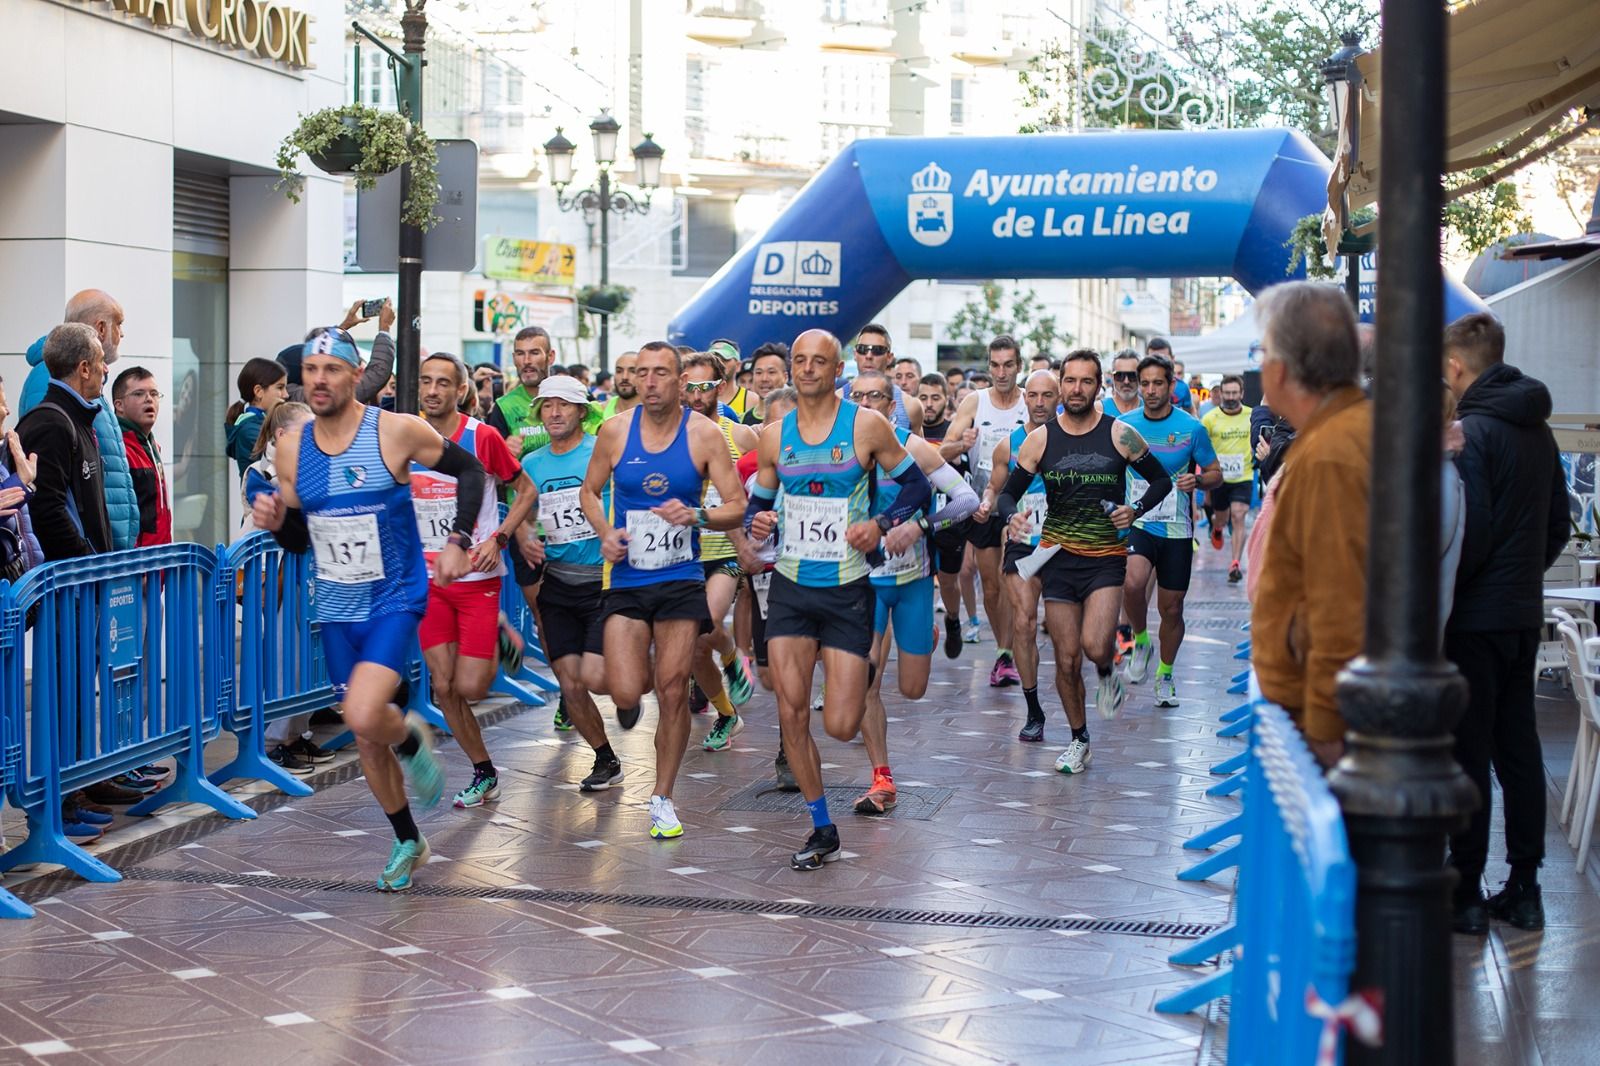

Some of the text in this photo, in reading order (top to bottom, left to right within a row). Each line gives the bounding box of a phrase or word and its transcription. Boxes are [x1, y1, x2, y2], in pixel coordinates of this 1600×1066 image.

[196, 0, 308, 67] CROOK
[963, 164, 1218, 206] Ayuntamiento
[992, 205, 1191, 238] de La Línea
[763, 253, 784, 275] D
[809, 288, 823, 297] DE
[748, 299, 839, 316] DEPORTES
[1081, 474, 1118, 484] TRAINING
[429, 517, 457, 537] 18
[552, 507, 586, 529] 153
[644, 526, 688, 553] 246
[799, 520, 838, 543] 156
[327, 541, 367, 565] 137
[110, 594, 134, 608] DEPORTES
